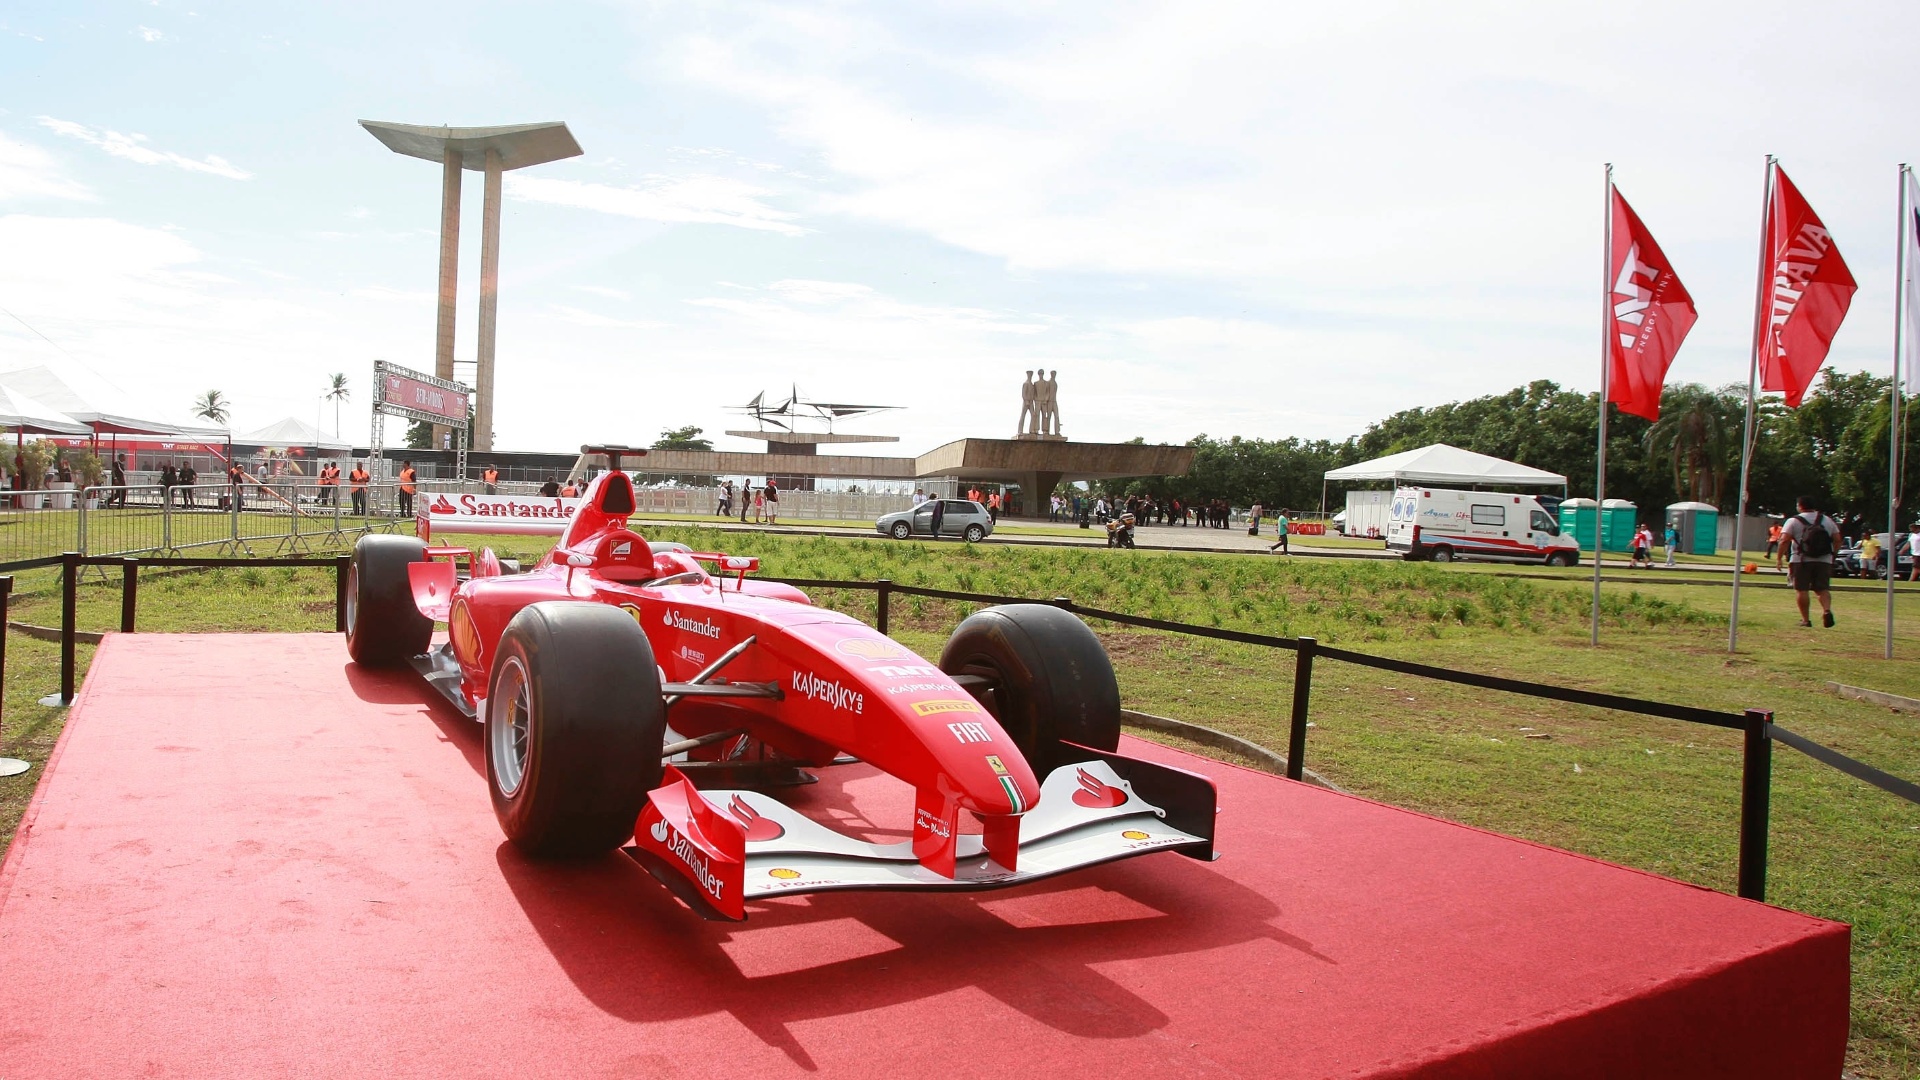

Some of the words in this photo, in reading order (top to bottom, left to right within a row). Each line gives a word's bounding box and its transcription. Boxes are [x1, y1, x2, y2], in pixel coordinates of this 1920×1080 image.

[461, 494, 575, 518] Santande
[673, 610, 721, 639] Santander
[865, 665, 934, 677] TNT
[792, 670, 857, 712] KASPERSKY
[887, 683, 956, 695] KASPERSKY
[946, 722, 993, 744] FIAT
[667, 828, 725, 900] Santander
